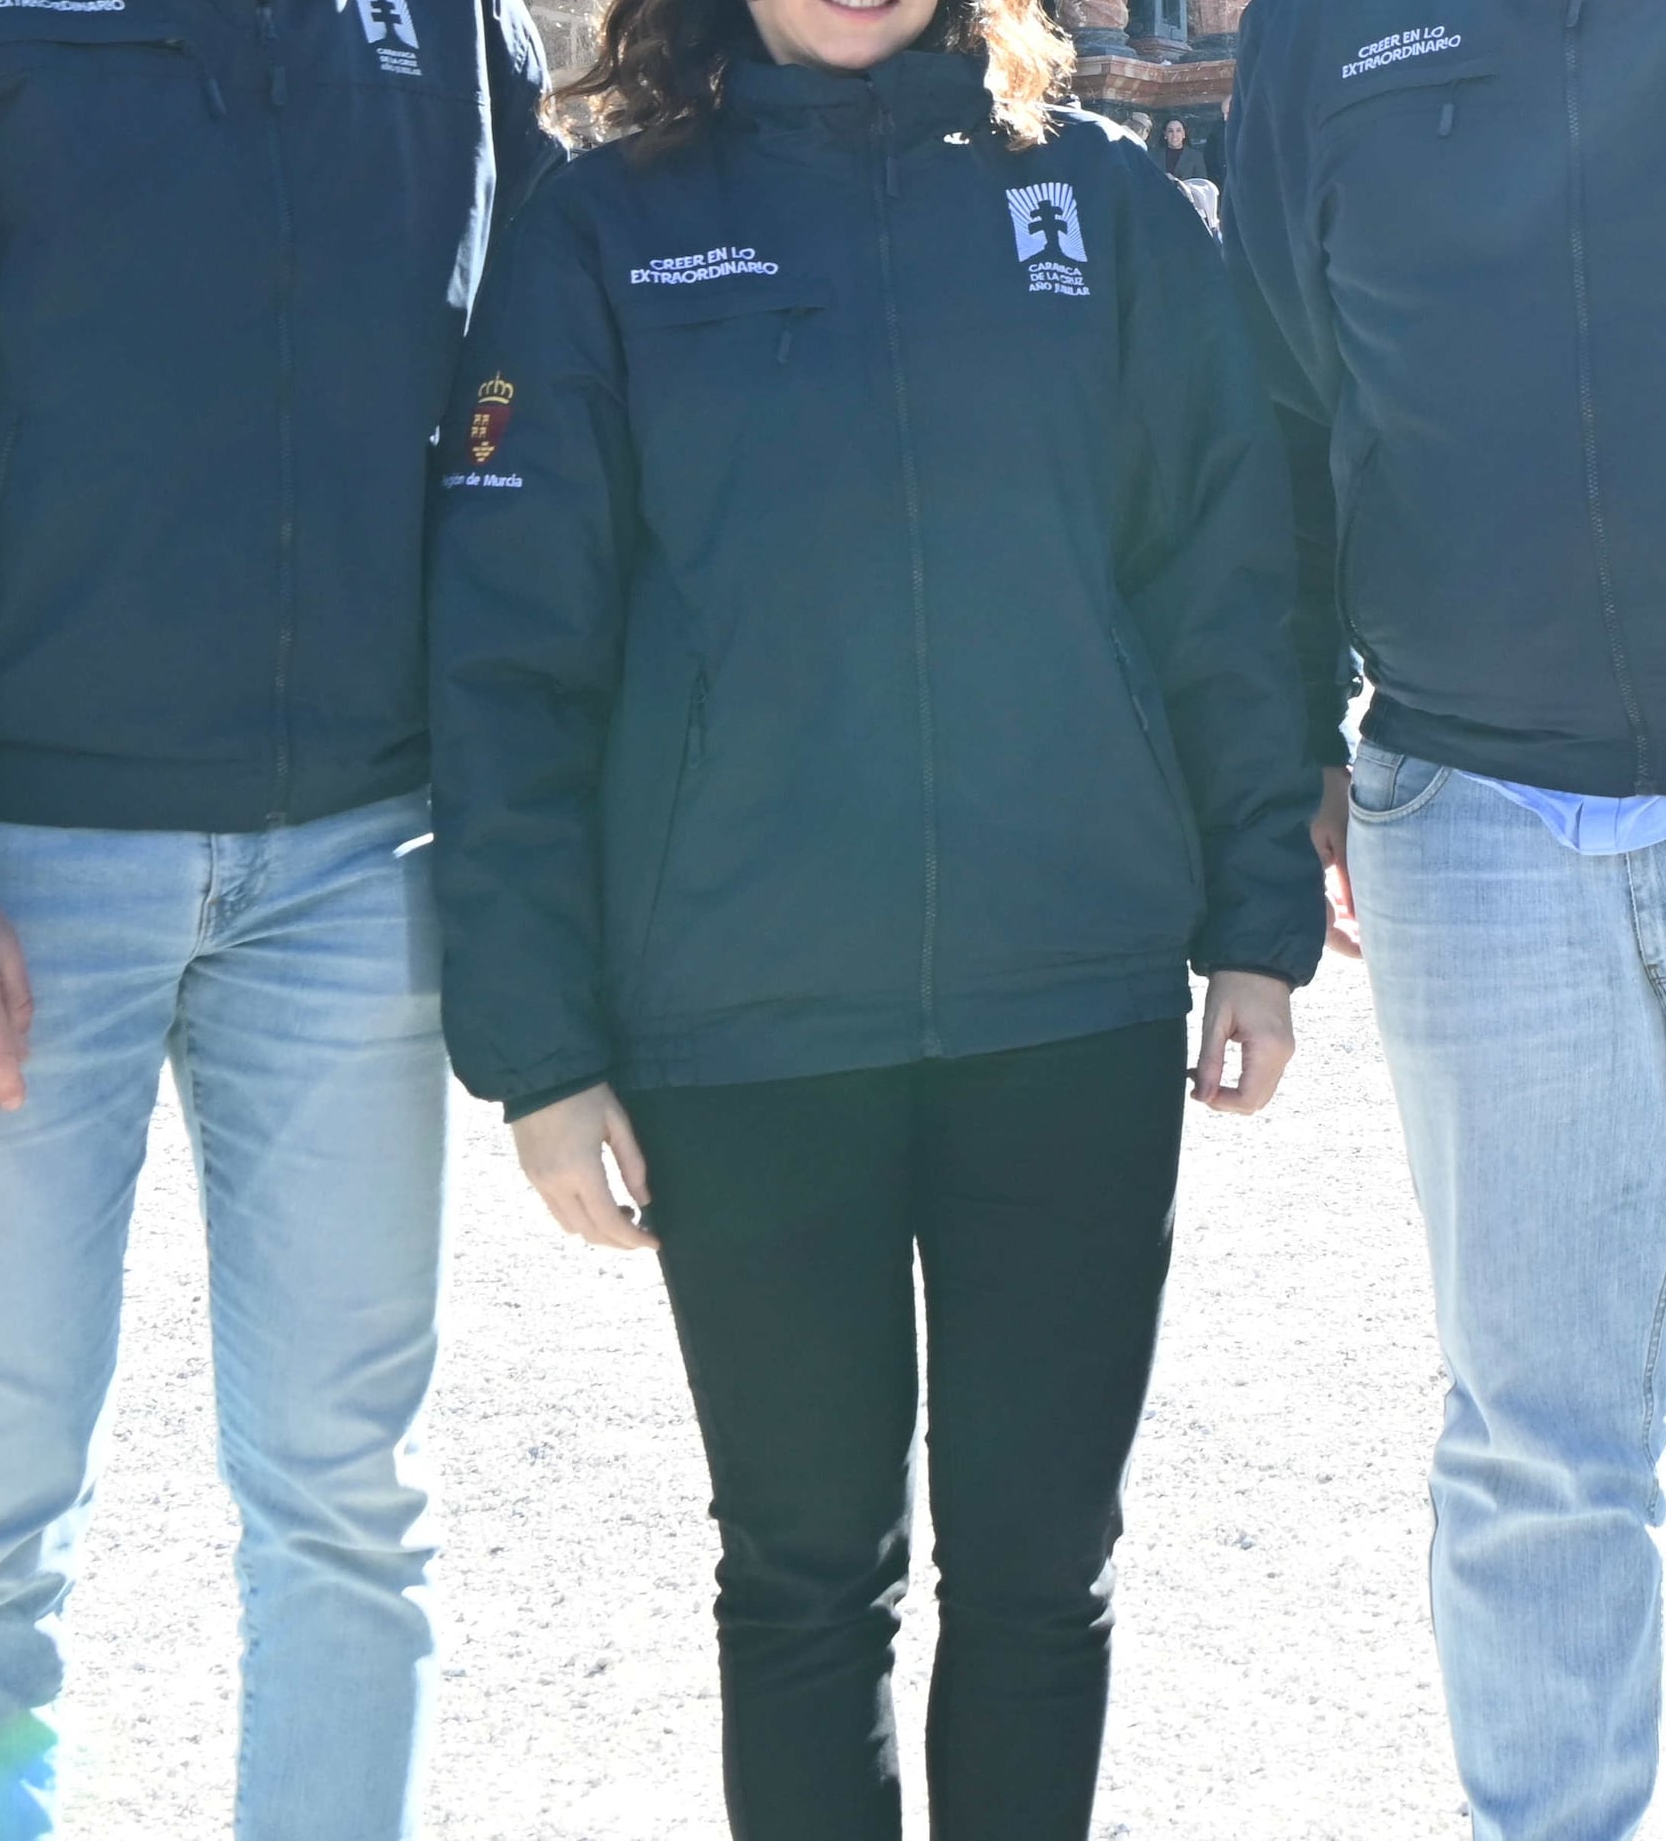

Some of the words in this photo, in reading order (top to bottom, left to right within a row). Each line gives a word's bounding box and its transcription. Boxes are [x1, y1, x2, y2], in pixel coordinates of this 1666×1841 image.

[1357, 34, 1401, 58] CREER
[1402, 28, 1421, 44] EN
[1423, 25, 1445, 39] LO
[1342, 34, 1461, 79] EXTRAORDINARIO
[649, 254, 706, 271] CREER
[707, 246, 728, 264] EN
[731, 246, 755, 260] LO
[1028, 261, 1082, 276] CARAVACA
[630, 260, 779, 285] EXTRAORDINARIO
[1030, 271, 1045, 282] DE
[1046, 271, 1060, 281] LA
[1059, 274, 1085, 286] CRUZ
[1029, 281, 1053, 292] AÑO
[465, 471, 481, 486] de
[483, 473, 523, 488] Murcia
